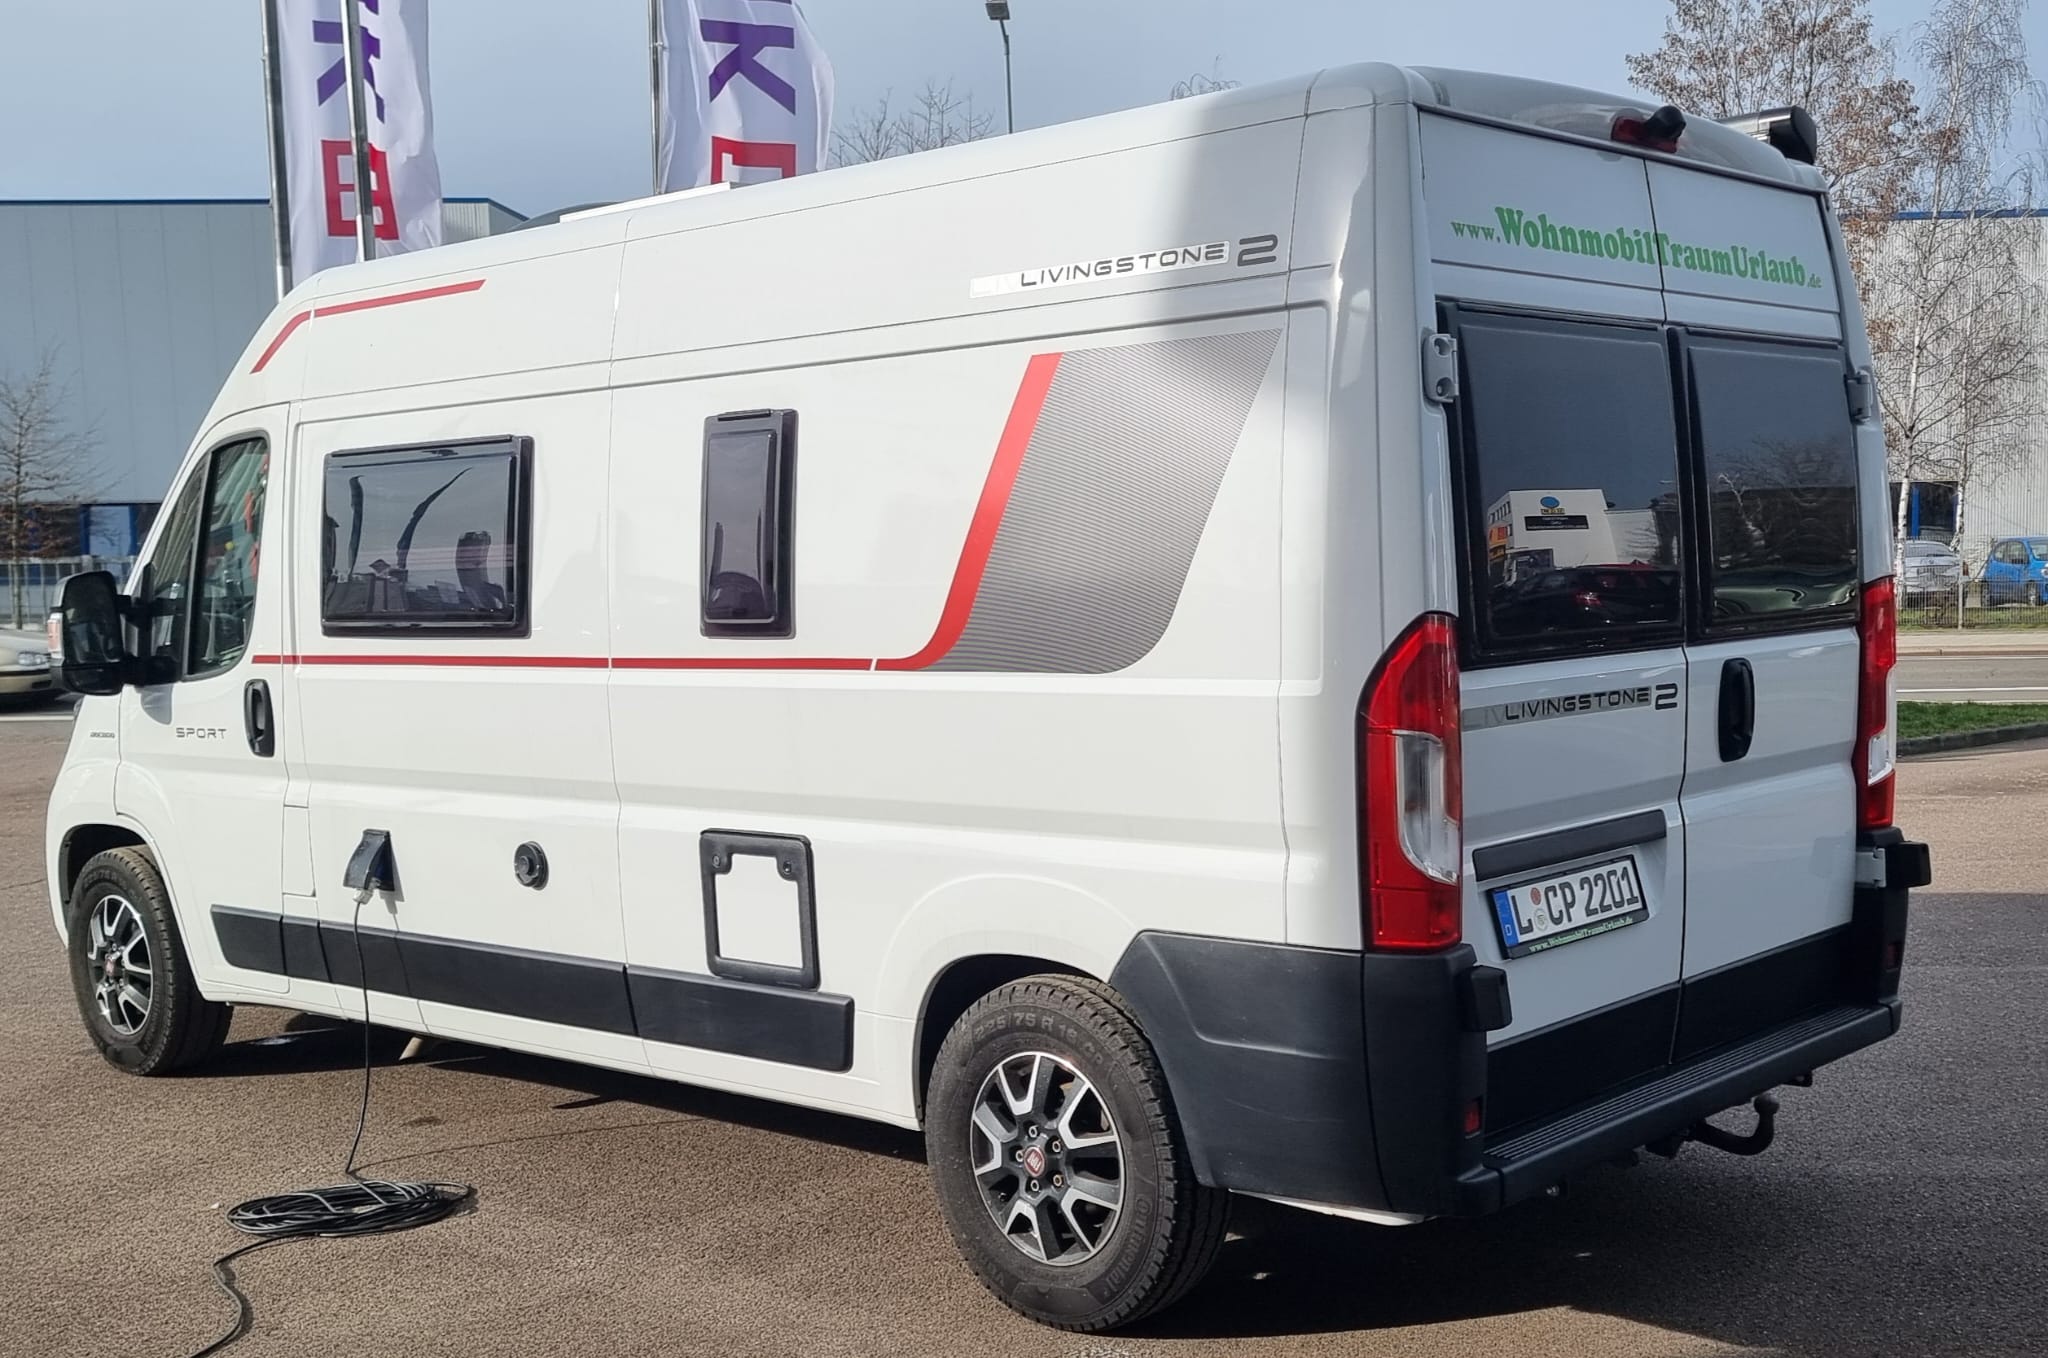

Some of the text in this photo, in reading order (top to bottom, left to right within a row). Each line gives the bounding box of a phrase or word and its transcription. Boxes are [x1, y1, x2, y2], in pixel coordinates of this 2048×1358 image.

[1020, 233, 1278, 287] LIVINGSTONE 2
[1450, 206, 1823, 289] www.WohnmobilTraumUrlaub.de
[1505, 682, 1678, 720] LIVINGSTONE 2
[176, 727, 227, 739] SPORT
[1511, 866, 1639, 935] L CP 2201
